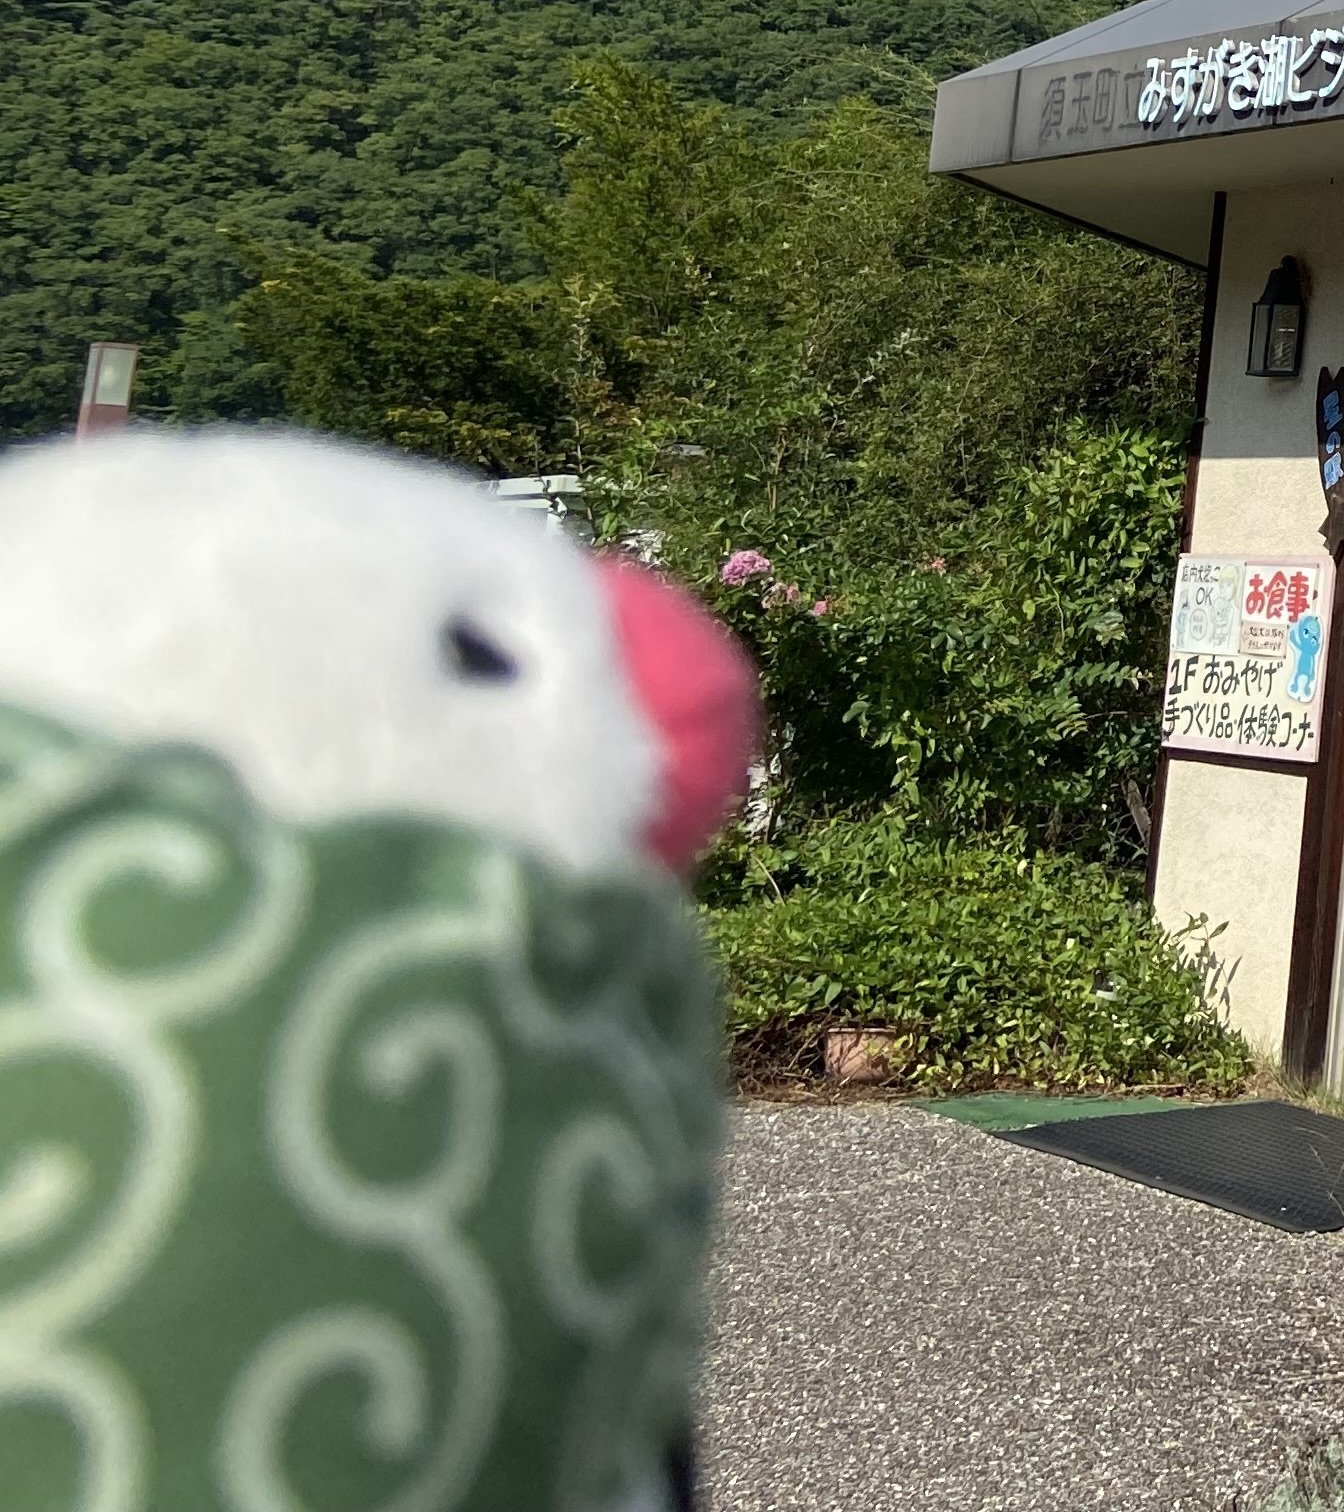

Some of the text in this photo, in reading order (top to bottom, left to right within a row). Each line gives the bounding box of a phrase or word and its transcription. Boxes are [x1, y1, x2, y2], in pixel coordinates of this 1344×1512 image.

[1195, 586, 1215, 606] OK
[1245, 570, 1310, 623] お食事
[1168, 655, 1284, 698] 1F おみやげ
